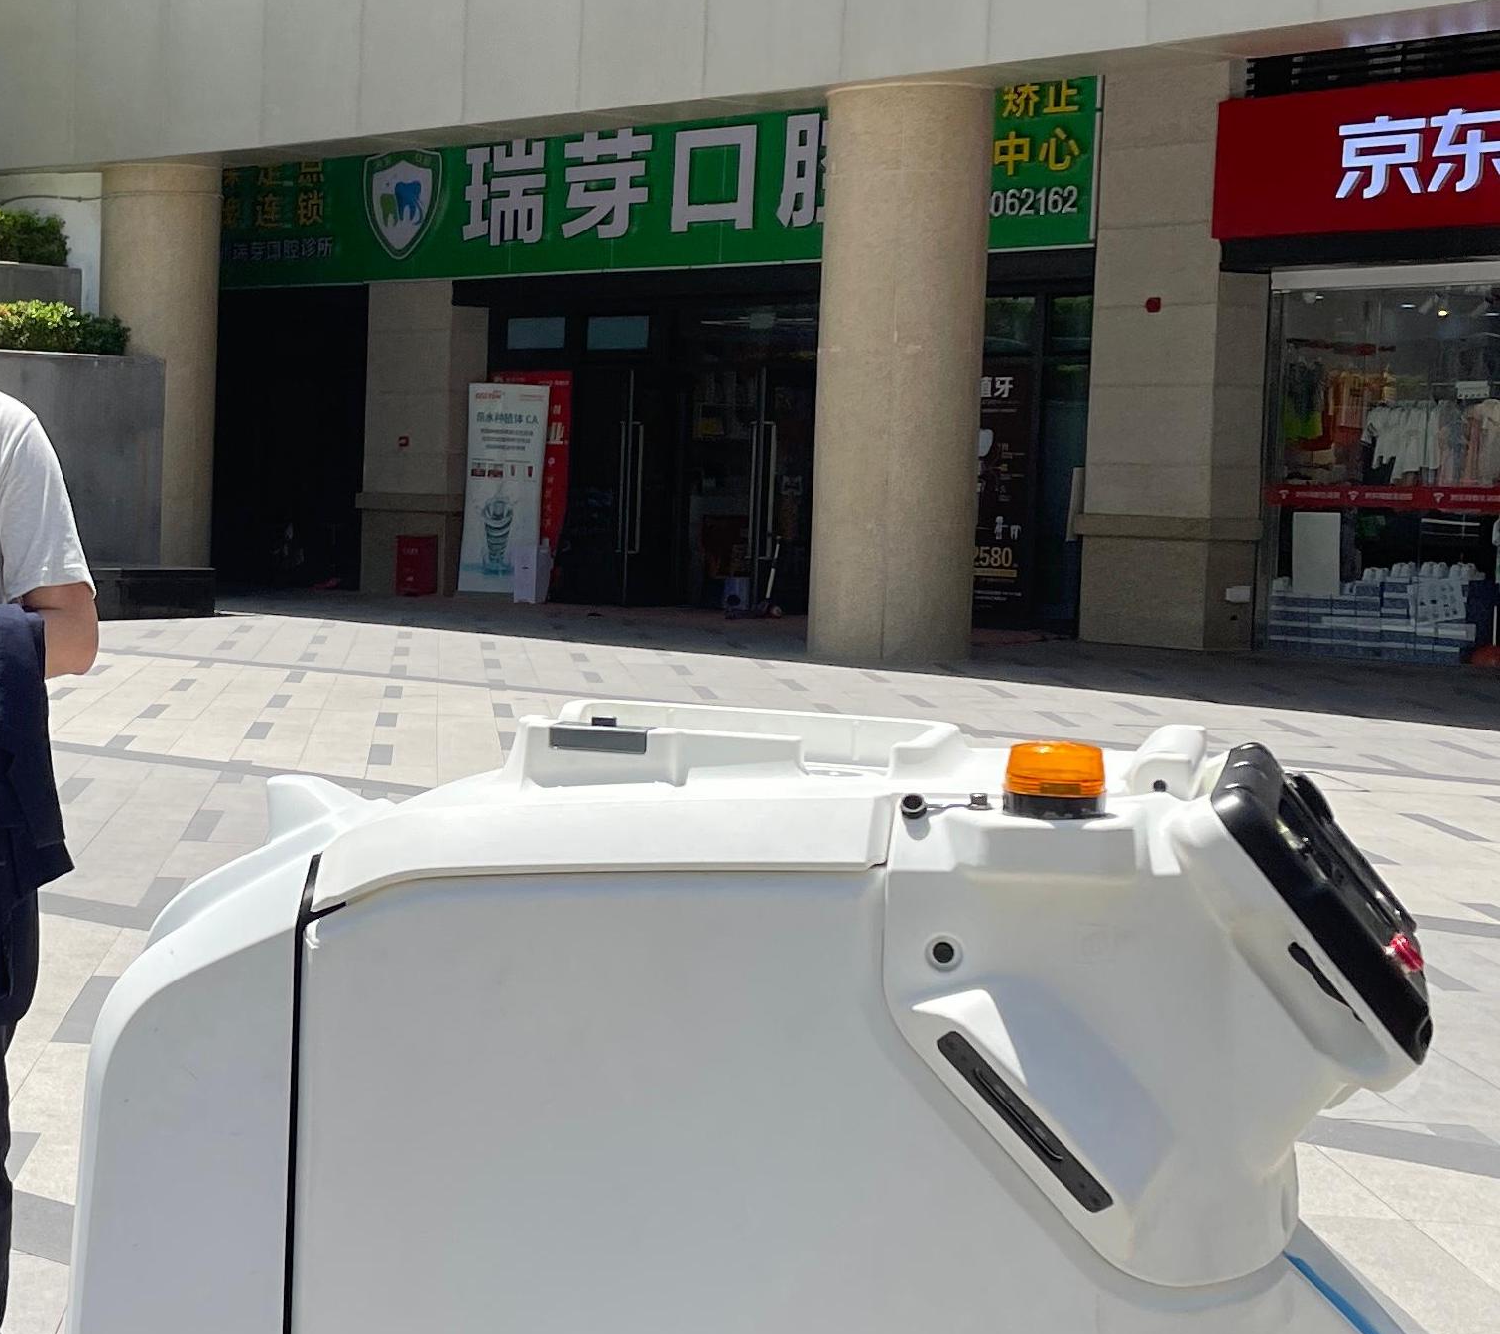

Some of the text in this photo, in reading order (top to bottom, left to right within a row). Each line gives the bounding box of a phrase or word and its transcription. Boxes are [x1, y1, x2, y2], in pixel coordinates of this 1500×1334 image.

[993, 126, 1080, 176] 中心
[1335, 108, 1500, 199] 京东
[989, 186, 1078, 218] 062162
